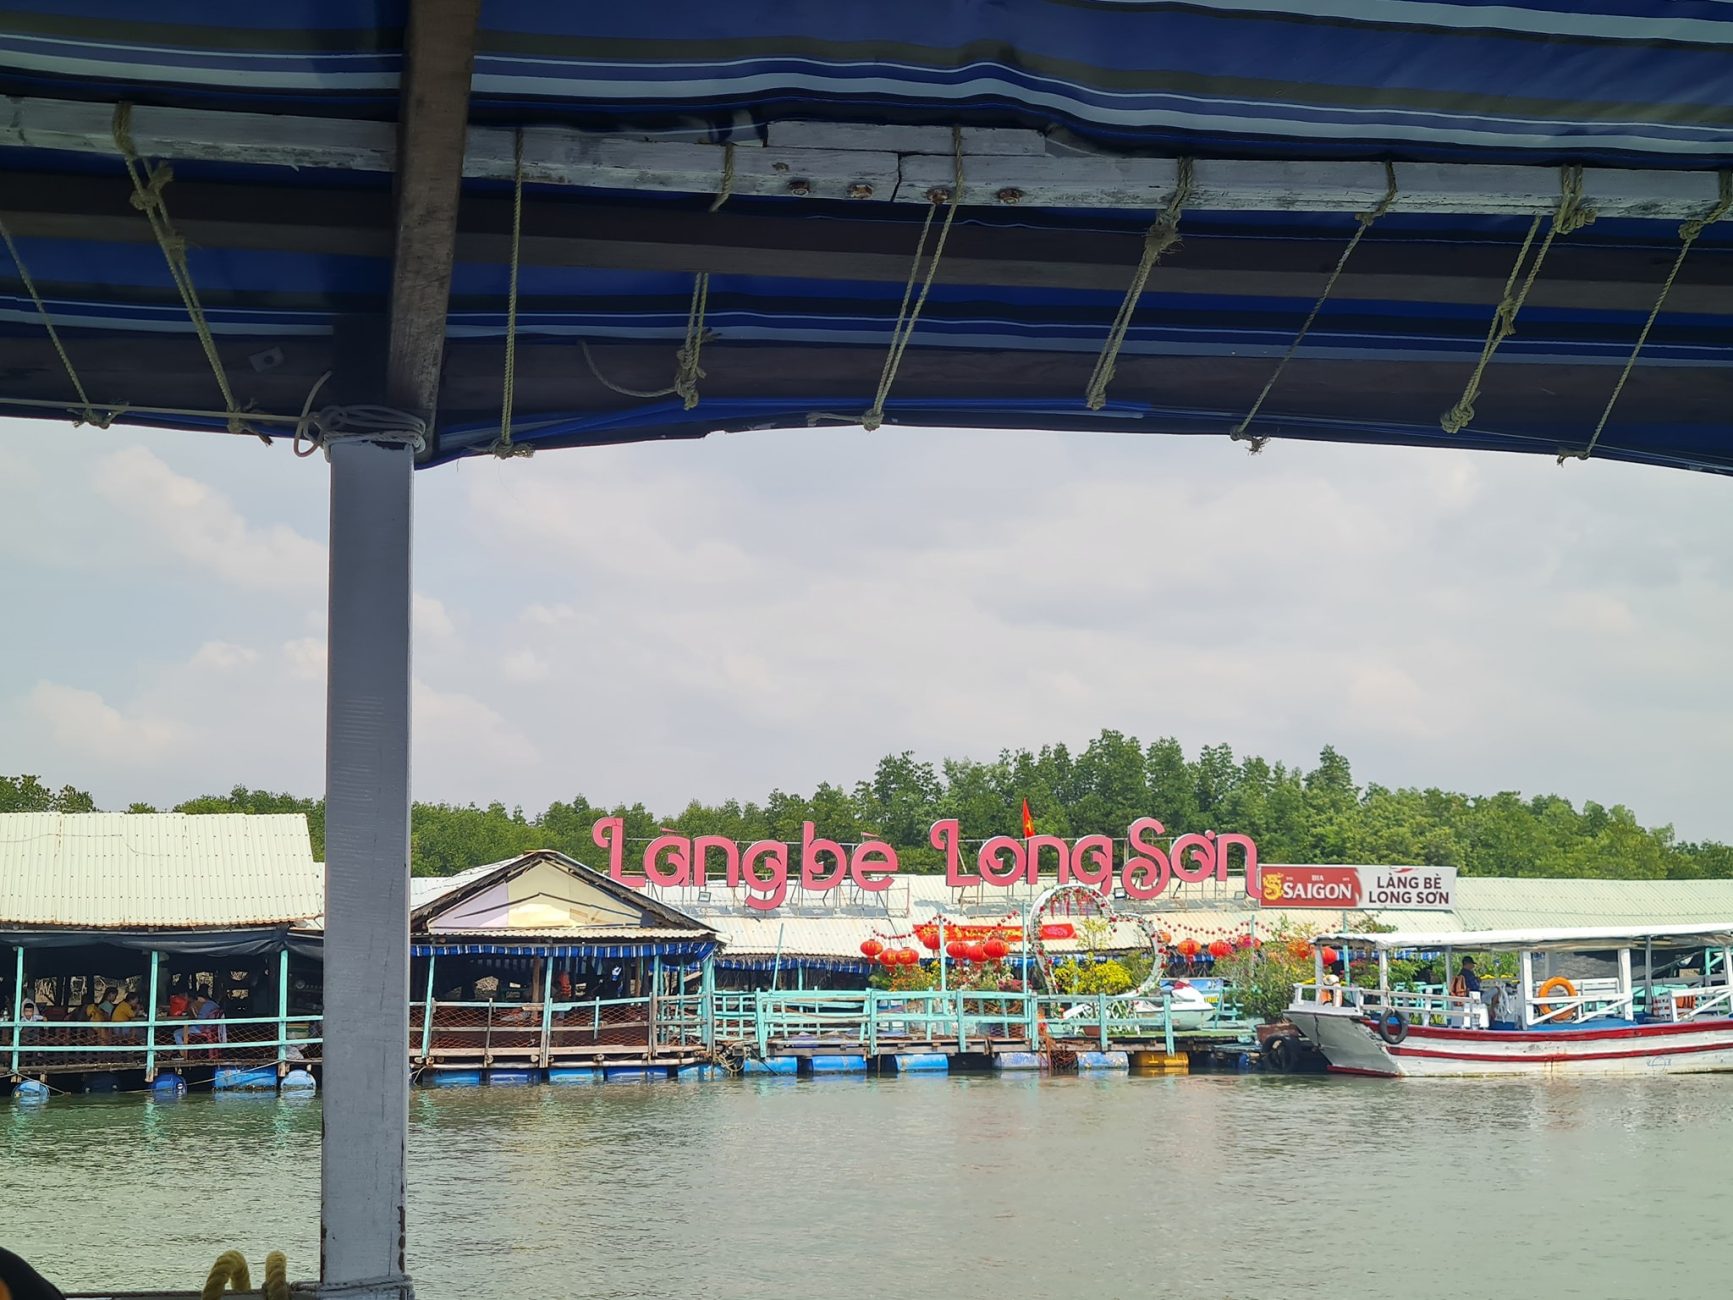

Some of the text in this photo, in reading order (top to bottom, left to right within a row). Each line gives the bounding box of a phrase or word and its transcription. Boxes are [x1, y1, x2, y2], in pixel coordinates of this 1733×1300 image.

[591, 816, 789, 911] Làng
[801, 820, 899, 892] bè
[929, 818, 1114, 897] Long
[1377, 872, 1442, 889] LÀNG BÈ
[1283, 882, 1352, 899] SAIGON
[1368, 890, 1449, 904] LONG SƠN
